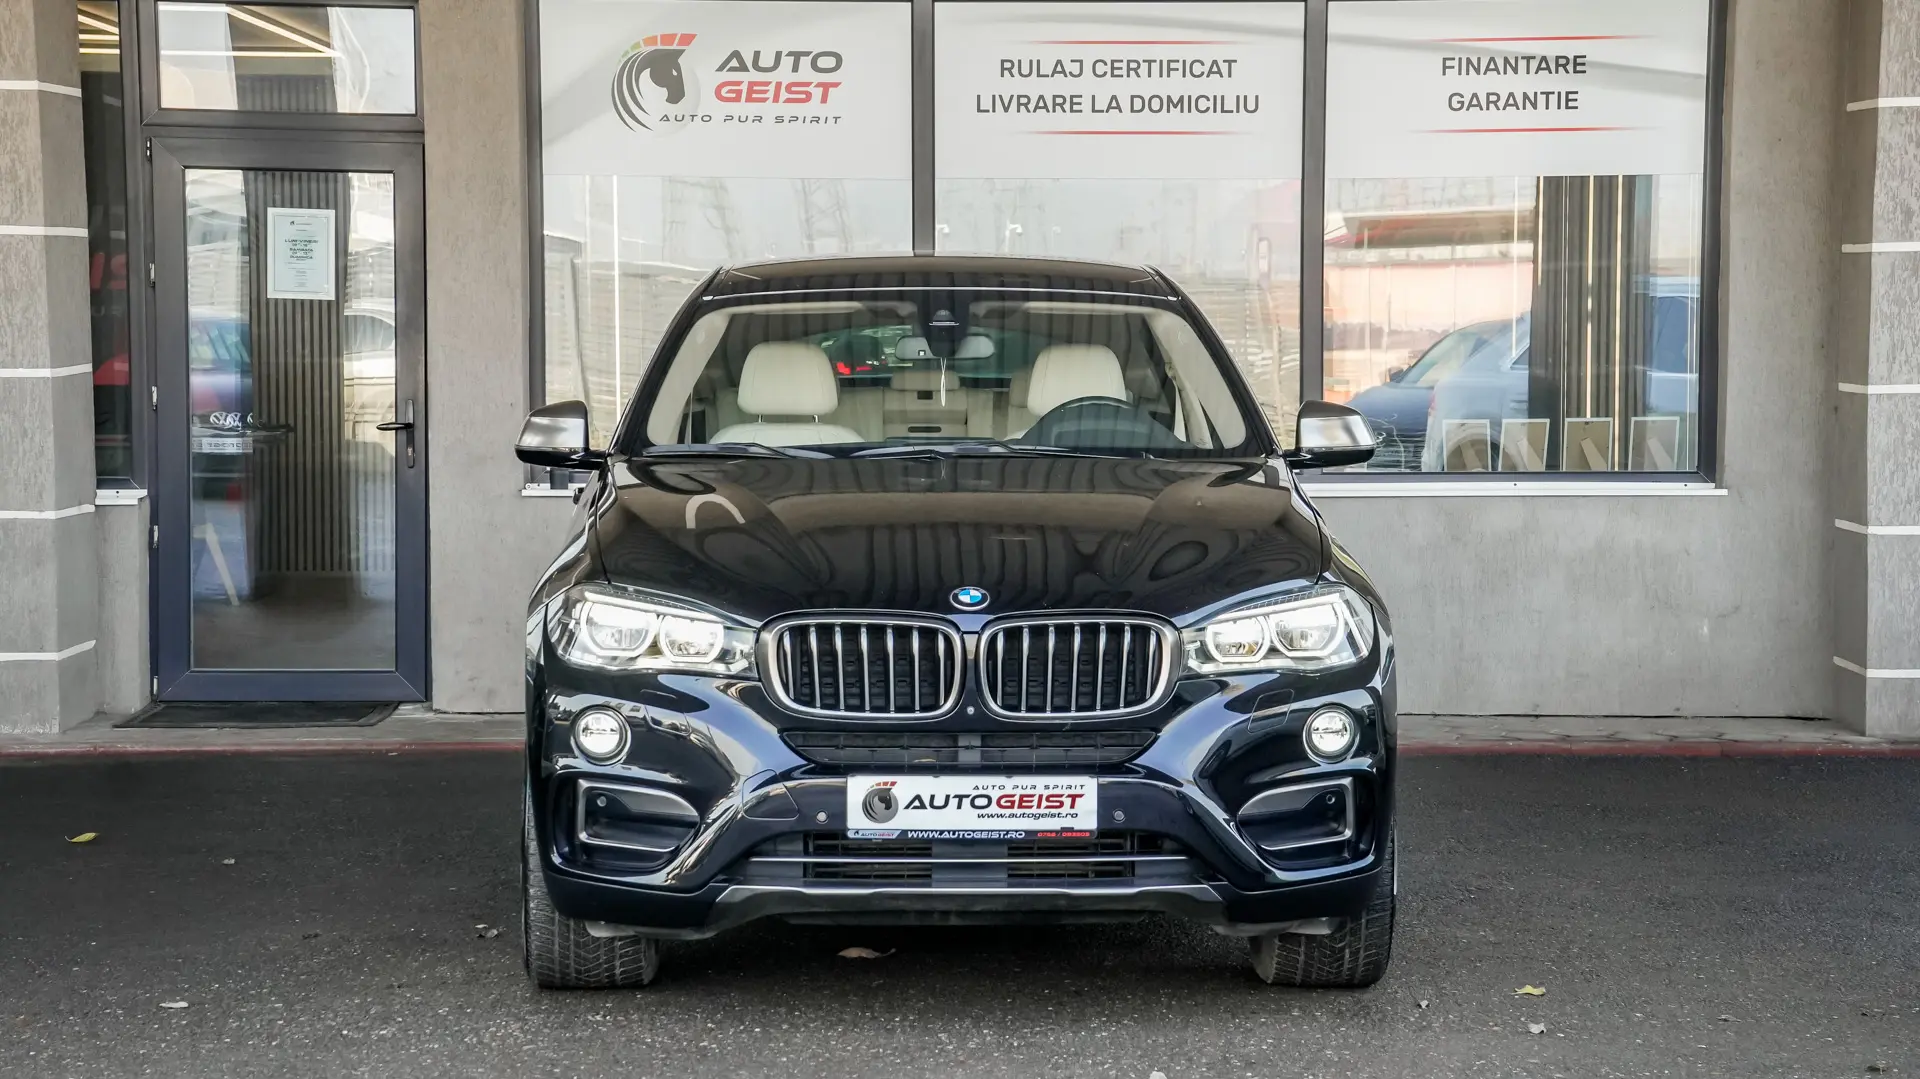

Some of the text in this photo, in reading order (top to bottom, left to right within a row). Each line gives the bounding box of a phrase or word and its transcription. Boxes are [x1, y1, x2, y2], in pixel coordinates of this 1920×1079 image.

[715, 50, 844, 73] AUTO
[1000, 58, 1238, 78] RULAJ CERTIFICAT
[1442, 54, 1587, 76] FINANTARE
[714, 80, 843, 104] GEIST
[1448, 90, 1579, 112] GARANTIE
[976, 94, 1260, 113] LIVRARE LA DOMICILIU
[659, 114, 842, 124] AUTO PUR SPIRIT
[904, 793, 1085, 810] AUTOGEIST
[977, 811, 1079, 820] www.autogeist.ro
[907, 831, 1026, 839] WWW.AUTOGEIST.RO
